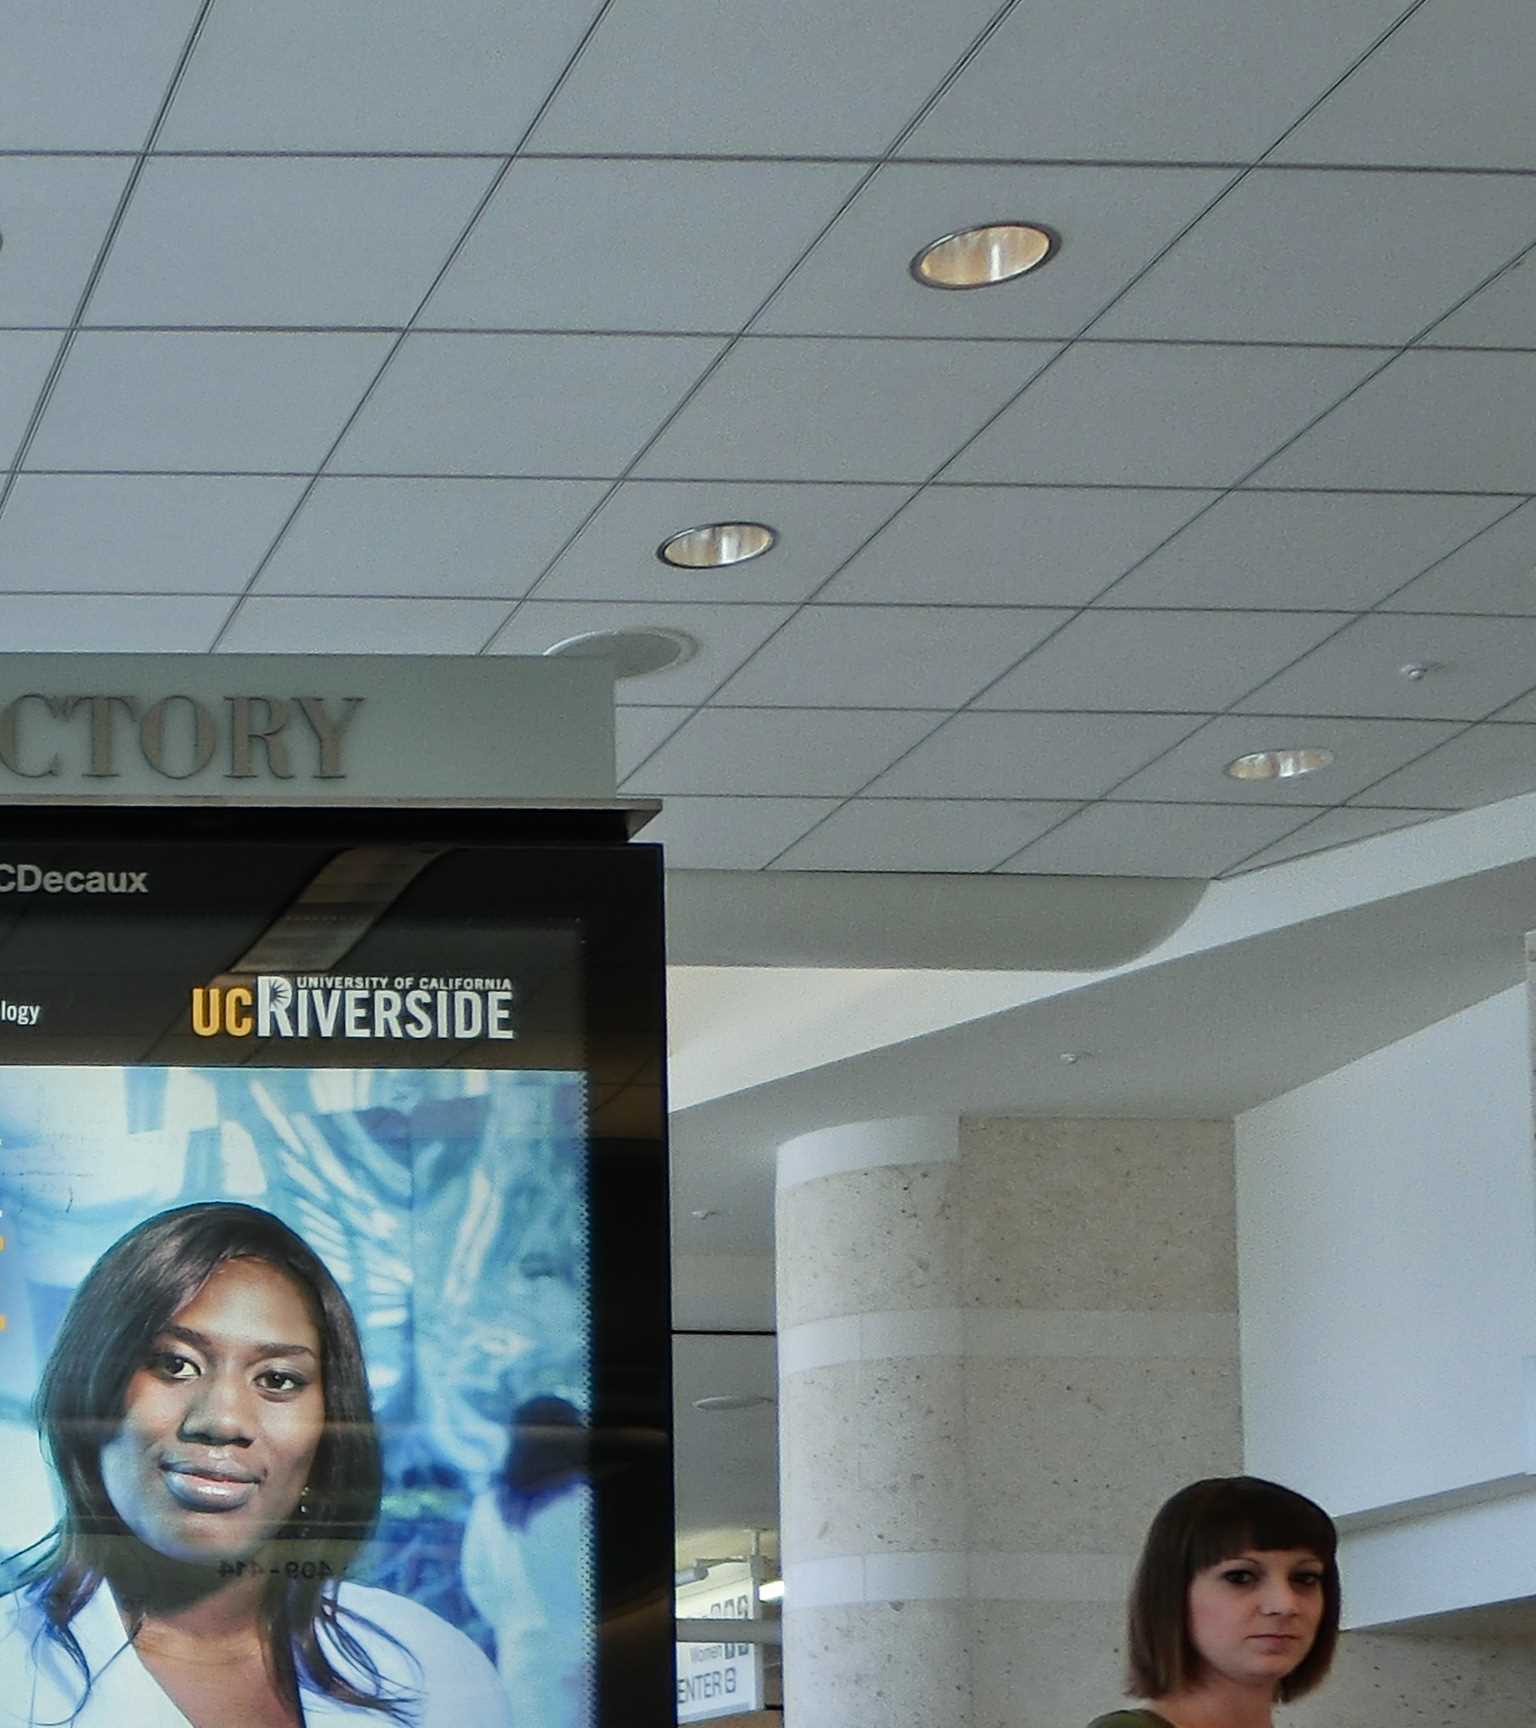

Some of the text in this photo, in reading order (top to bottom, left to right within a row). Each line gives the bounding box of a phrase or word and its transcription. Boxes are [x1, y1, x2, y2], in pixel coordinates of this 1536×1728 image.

[296, 976, 513, 991] UNIVERSITY OF CALIFORNIA
